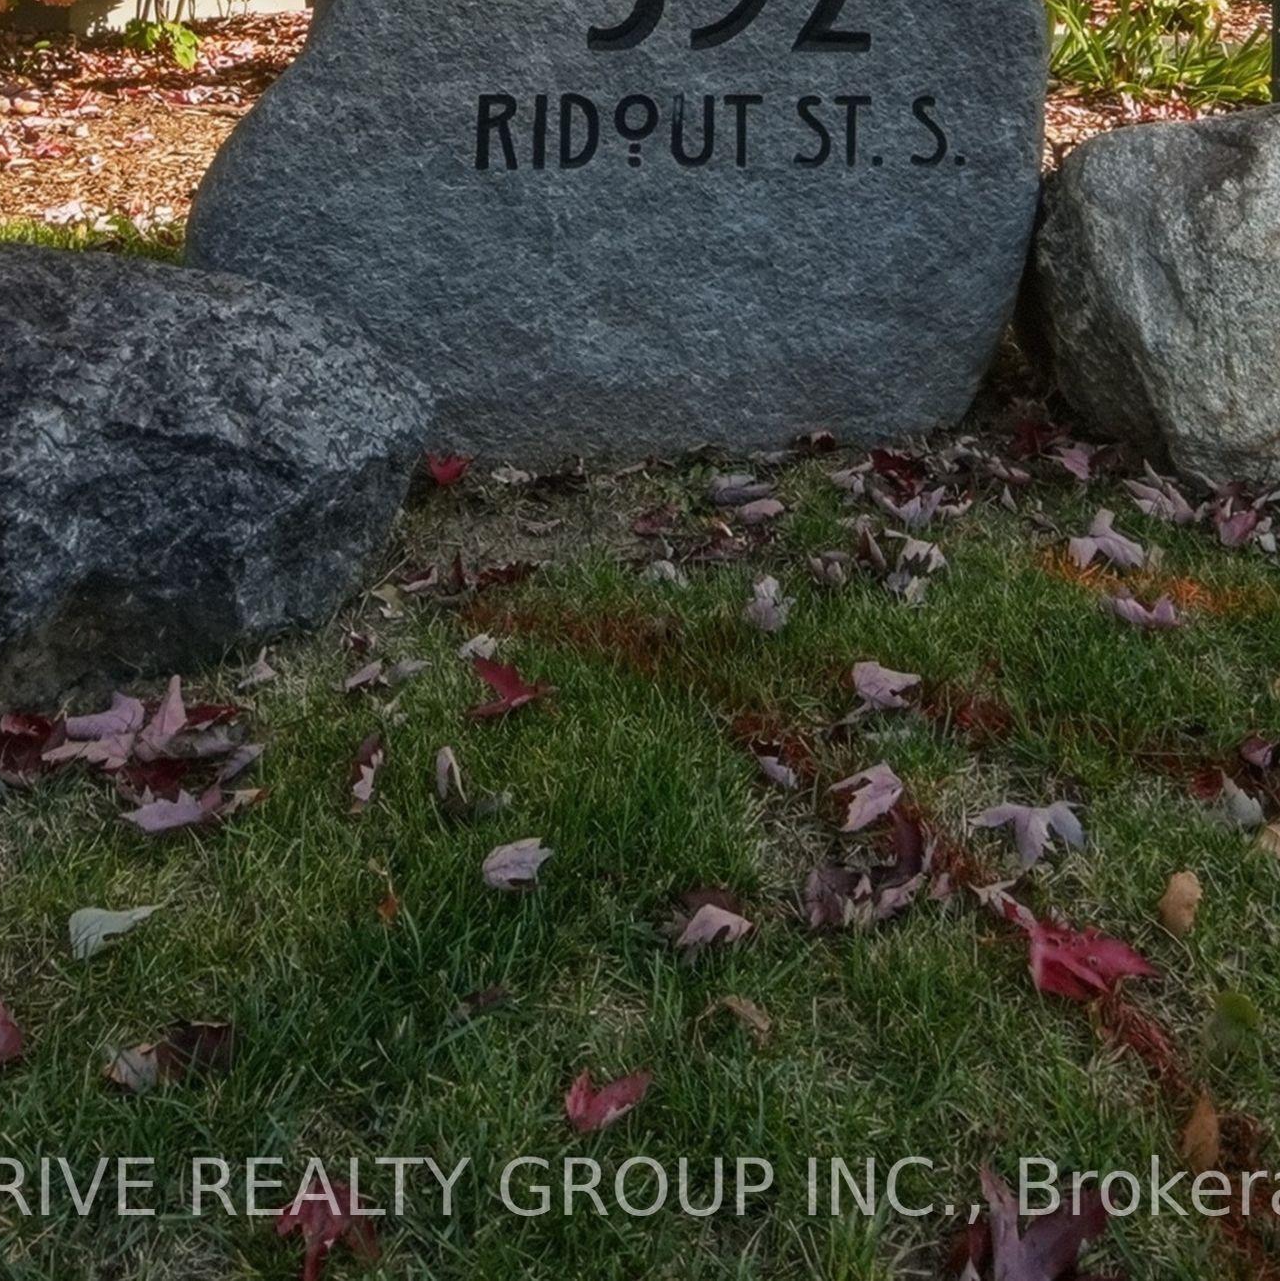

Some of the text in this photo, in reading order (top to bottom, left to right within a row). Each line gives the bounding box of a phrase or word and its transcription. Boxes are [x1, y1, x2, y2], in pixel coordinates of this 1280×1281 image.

[475, 92, 966, 170] RIDOUT ST. S.
